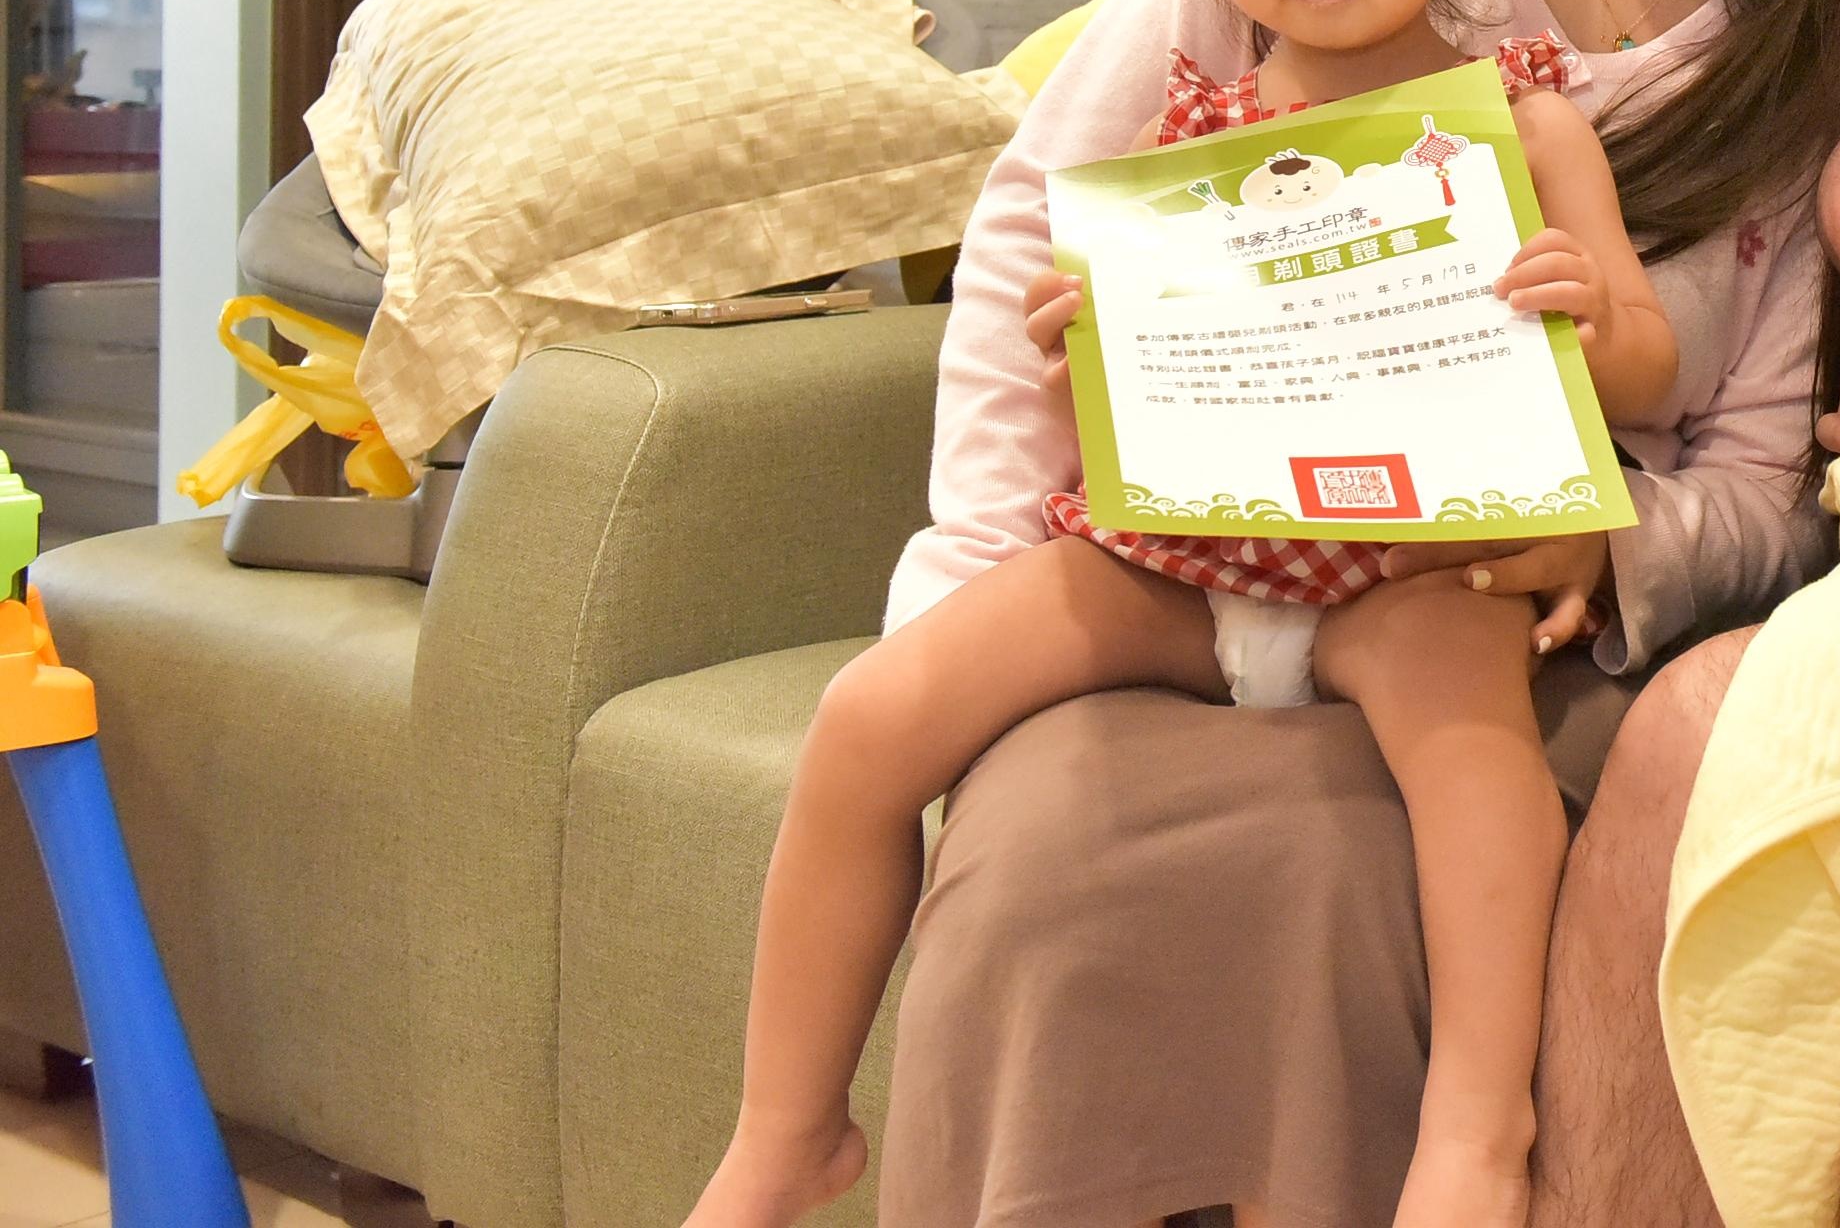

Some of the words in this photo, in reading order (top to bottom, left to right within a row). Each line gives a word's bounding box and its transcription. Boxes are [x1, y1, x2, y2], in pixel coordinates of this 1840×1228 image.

[1223, 206, 1369, 252] 傳家手工印章
[1377, 283, 1391, 296] 年
[1421, 274, 1433, 286] 月
[1465, 263, 1476, 275] 日
